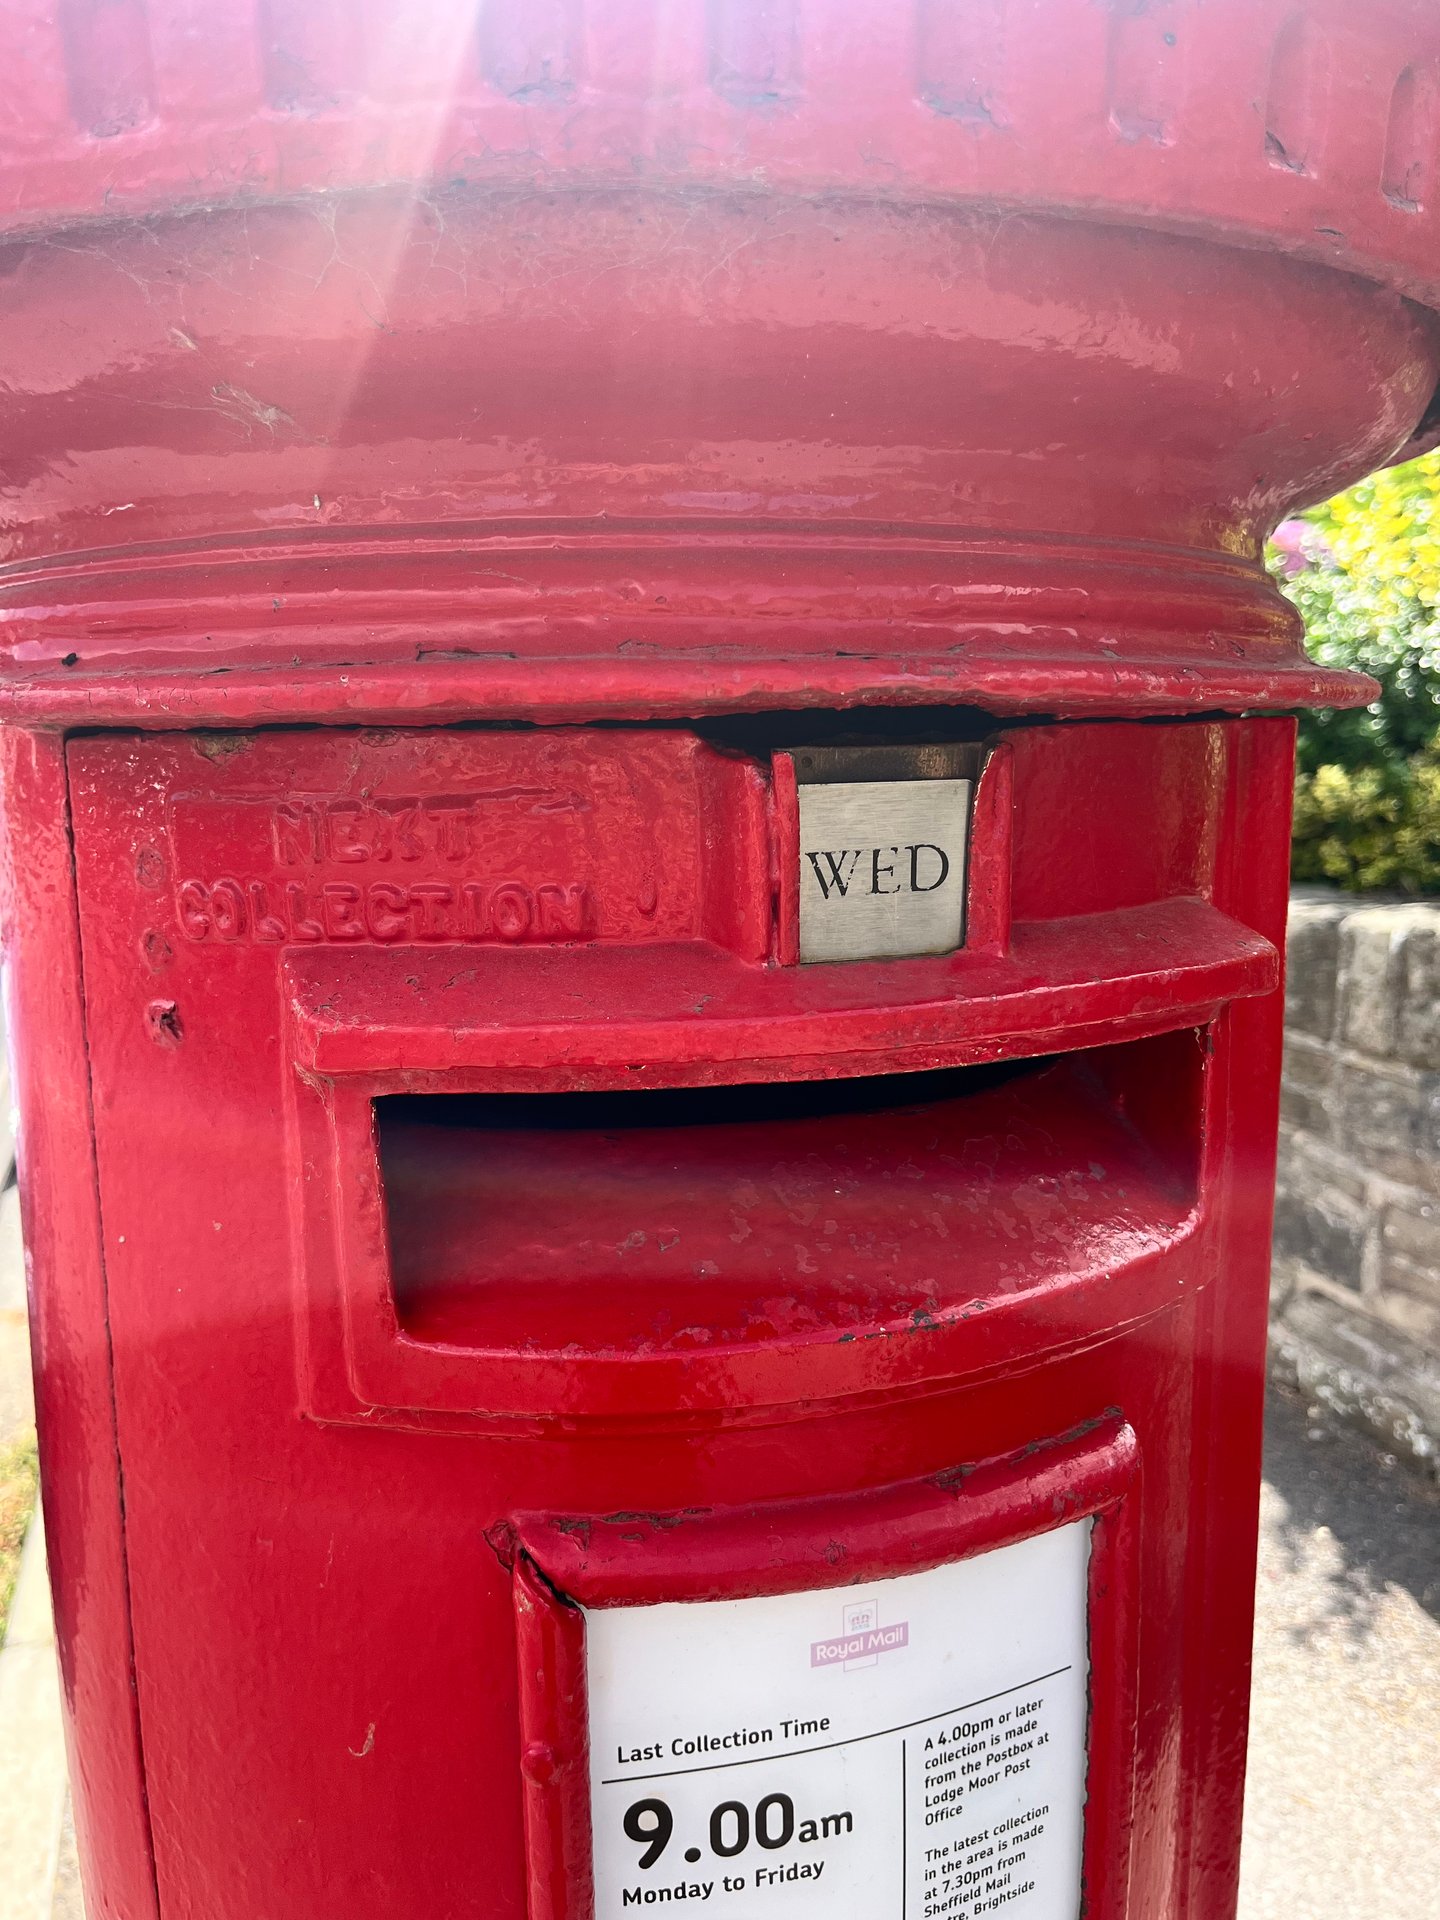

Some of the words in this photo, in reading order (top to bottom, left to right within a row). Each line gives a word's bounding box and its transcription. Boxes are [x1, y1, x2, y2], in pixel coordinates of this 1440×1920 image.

[272, 803, 474, 866] NEXT
[805, 844, 949, 900] WED
[176, 879, 590, 942] COLLECTION
[816, 1637, 863, 1661] Royal
[867, 1627, 903, 1649] Mail
[617, 1743, 663, 1763] Last
[671, 1728, 773, 1756] Collection
[780, 1717, 831, 1738] Time
[924, 1737, 934, 1751] A
[938, 1717, 994, 1745] 4.00pm
[998, 1711, 1012, 1724] or
[1015, 1698, 1044, 1717] later
[924, 1740, 986, 1770] collection
[990, 1734, 1001, 1746] is
[1005, 1719, 1038, 1740] made
[924, 1770, 956, 1789] from
[961, 1761, 981, 1775] the
[986, 1740, 1033, 1766] Postbox
[1037, 1731, 1049, 1746] at
[925, 1786, 964, 1808] Lodge
[968, 1771, 1000, 1792] Moor
[1004, 1758, 1031, 1777] Post
[622, 1792, 854, 1870] 9.00am
[924, 1846, 949, 1862] The
[953, 1829, 989, 1852] latest
[993, 1804, 1049, 1836] collection
[925, 1804, 963, 1826] Office
[924, 1869, 937, 1881] in
[941, 1860, 962, 1875] the
[966, 1846, 994, 1865] area
[998, 1839, 1008, 1851] is
[1012, 1824, 1044, 1846] made
[924, 1886, 938, 1901] at
[942, 1865, 993, 1894] 7.30pm
[997, 1851, 1026, 1871] from
[622, 1880, 714, 1907] Monday
[722, 1876, 746, 1892] to
[755, 1860, 825, 1888] Friday
[924, 1885, 981, 1918] Sheffield
[985, 1872, 1011, 1893] Mail
[973, 1880, 1035, 1915] Brightside
